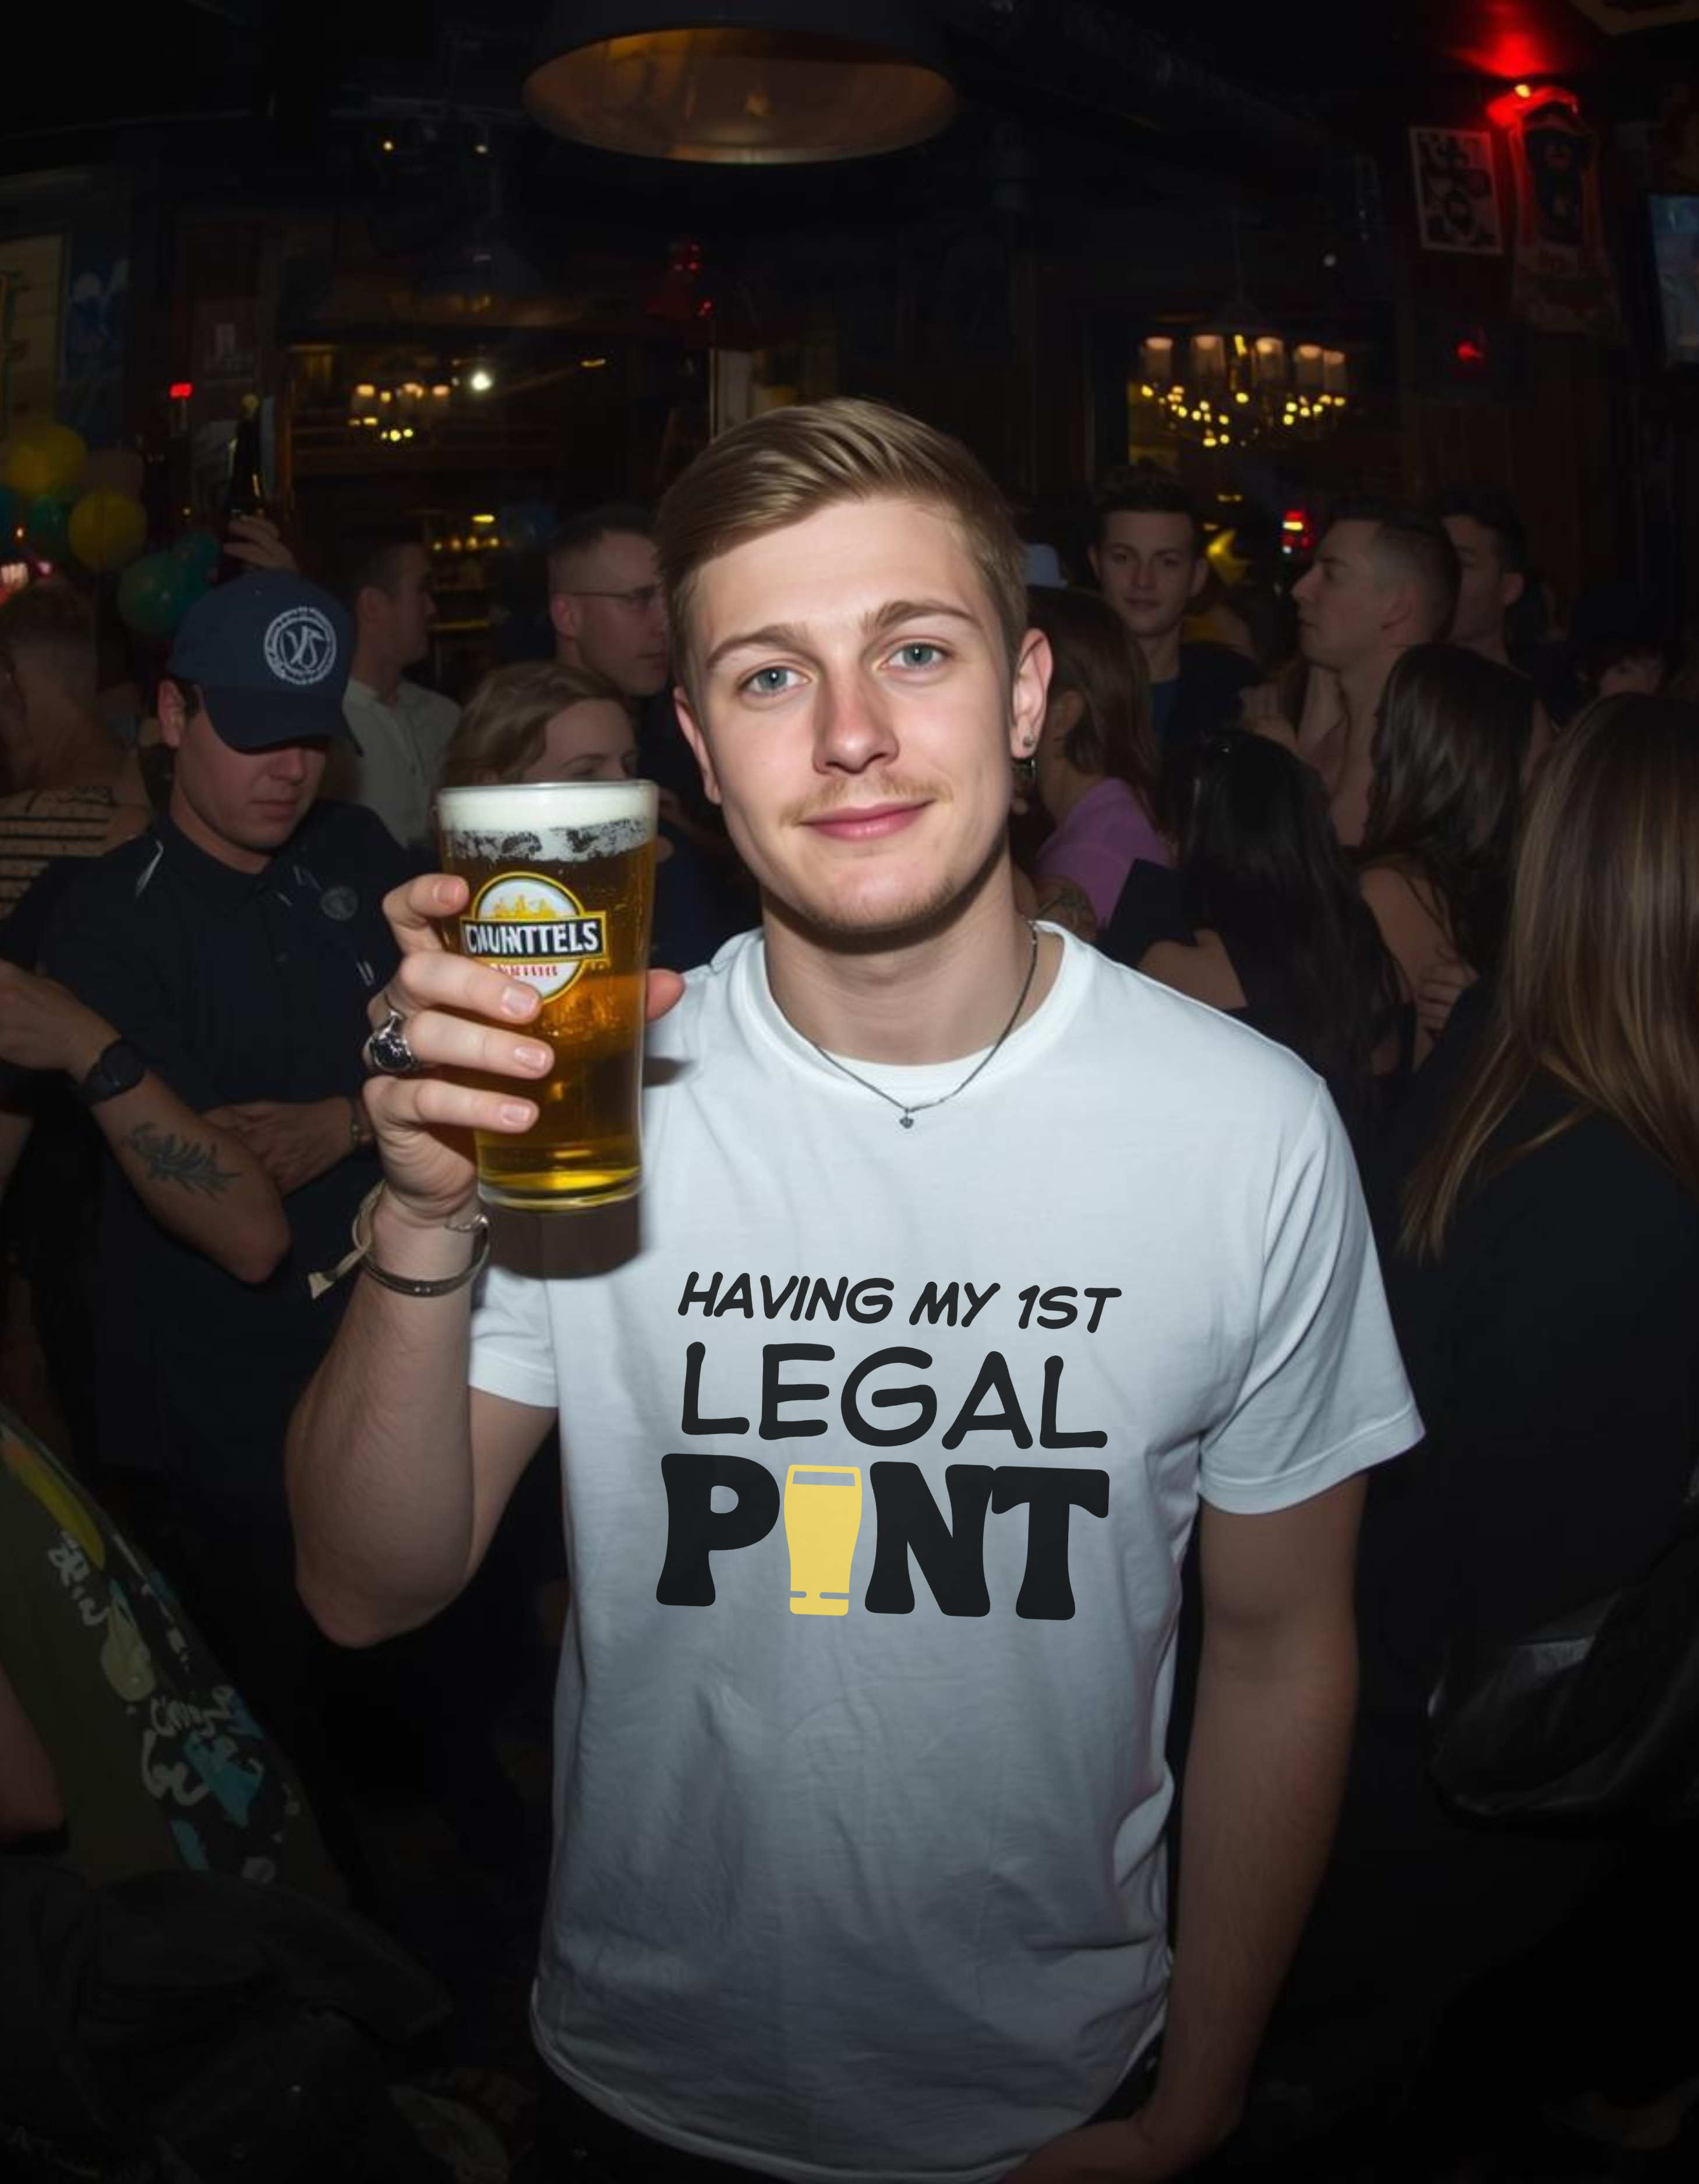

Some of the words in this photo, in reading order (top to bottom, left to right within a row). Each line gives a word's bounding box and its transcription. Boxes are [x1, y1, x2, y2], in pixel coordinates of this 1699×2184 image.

[677, 1271, 895, 1324] HAVING
[909, 1281, 1001, 1328] MY
[1018, 1284, 1122, 1334] 1ST
[681, 1341, 1108, 1451] LEGAL
